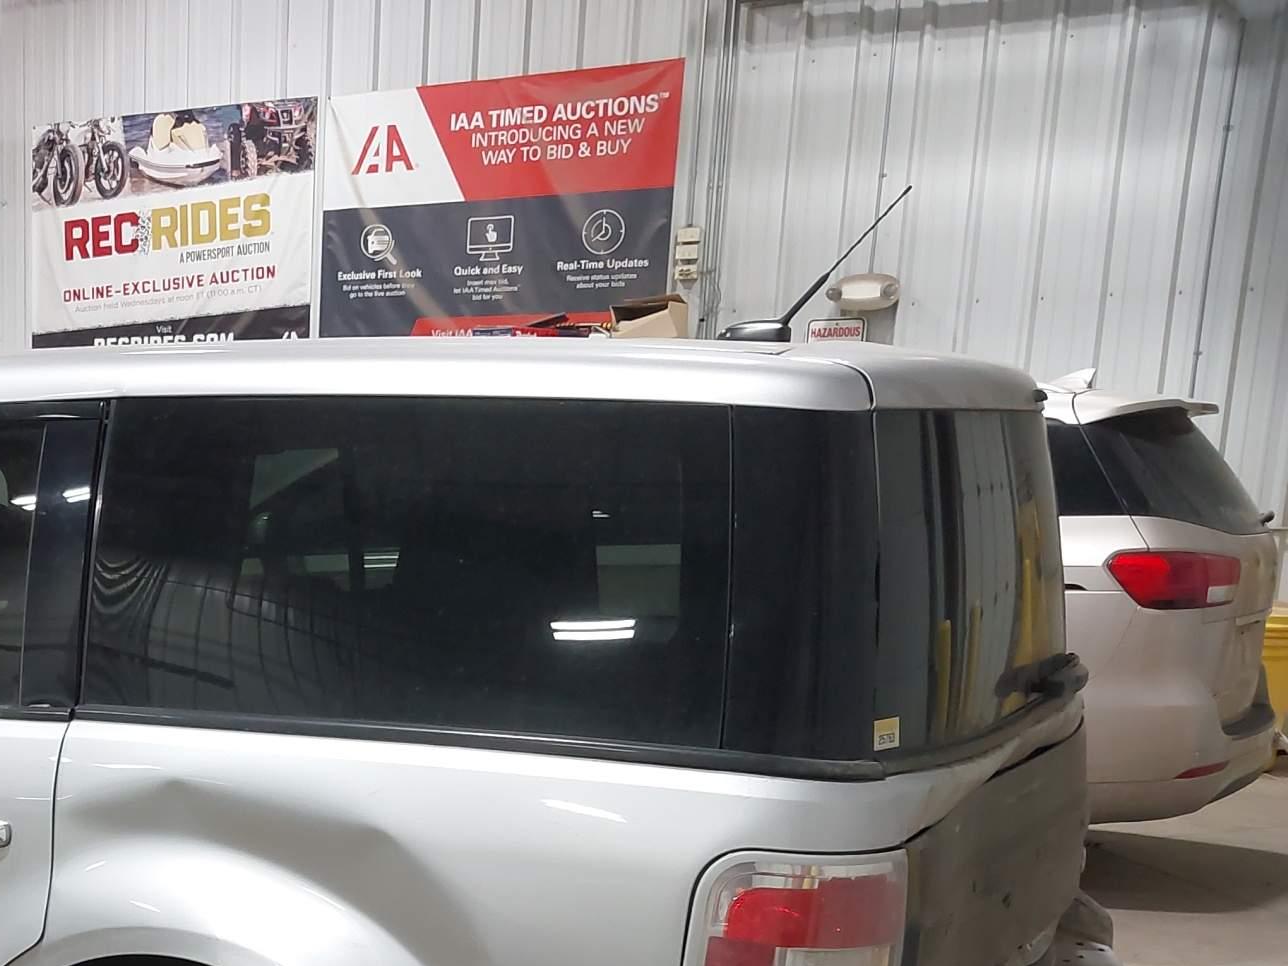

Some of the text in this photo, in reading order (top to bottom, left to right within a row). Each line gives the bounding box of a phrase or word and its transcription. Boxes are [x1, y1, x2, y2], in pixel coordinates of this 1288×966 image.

[450, 111, 485, 131] IAA
[488, 105, 547, 128] TIMED
[471, 118, 645, 148] INTRODUCING A NEW
[481, 138, 632, 166] WAY TO BID & BUY
[64, 193, 271, 261] REC RIDES
[179, 242, 271, 264] A POWERSPORT AUCTION
[337, 268, 422, 281] Exclusive First Look
[454, 264, 524, 276] Quick and Easy
[557, 258, 649, 271] Real-Time Updates
[63, 265, 276, 303] ONLINE-EXCLUSIVE AUCTION
[155, 325, 173, 333] Visit
[811, 326, 861, 338] HAZARDOUS
